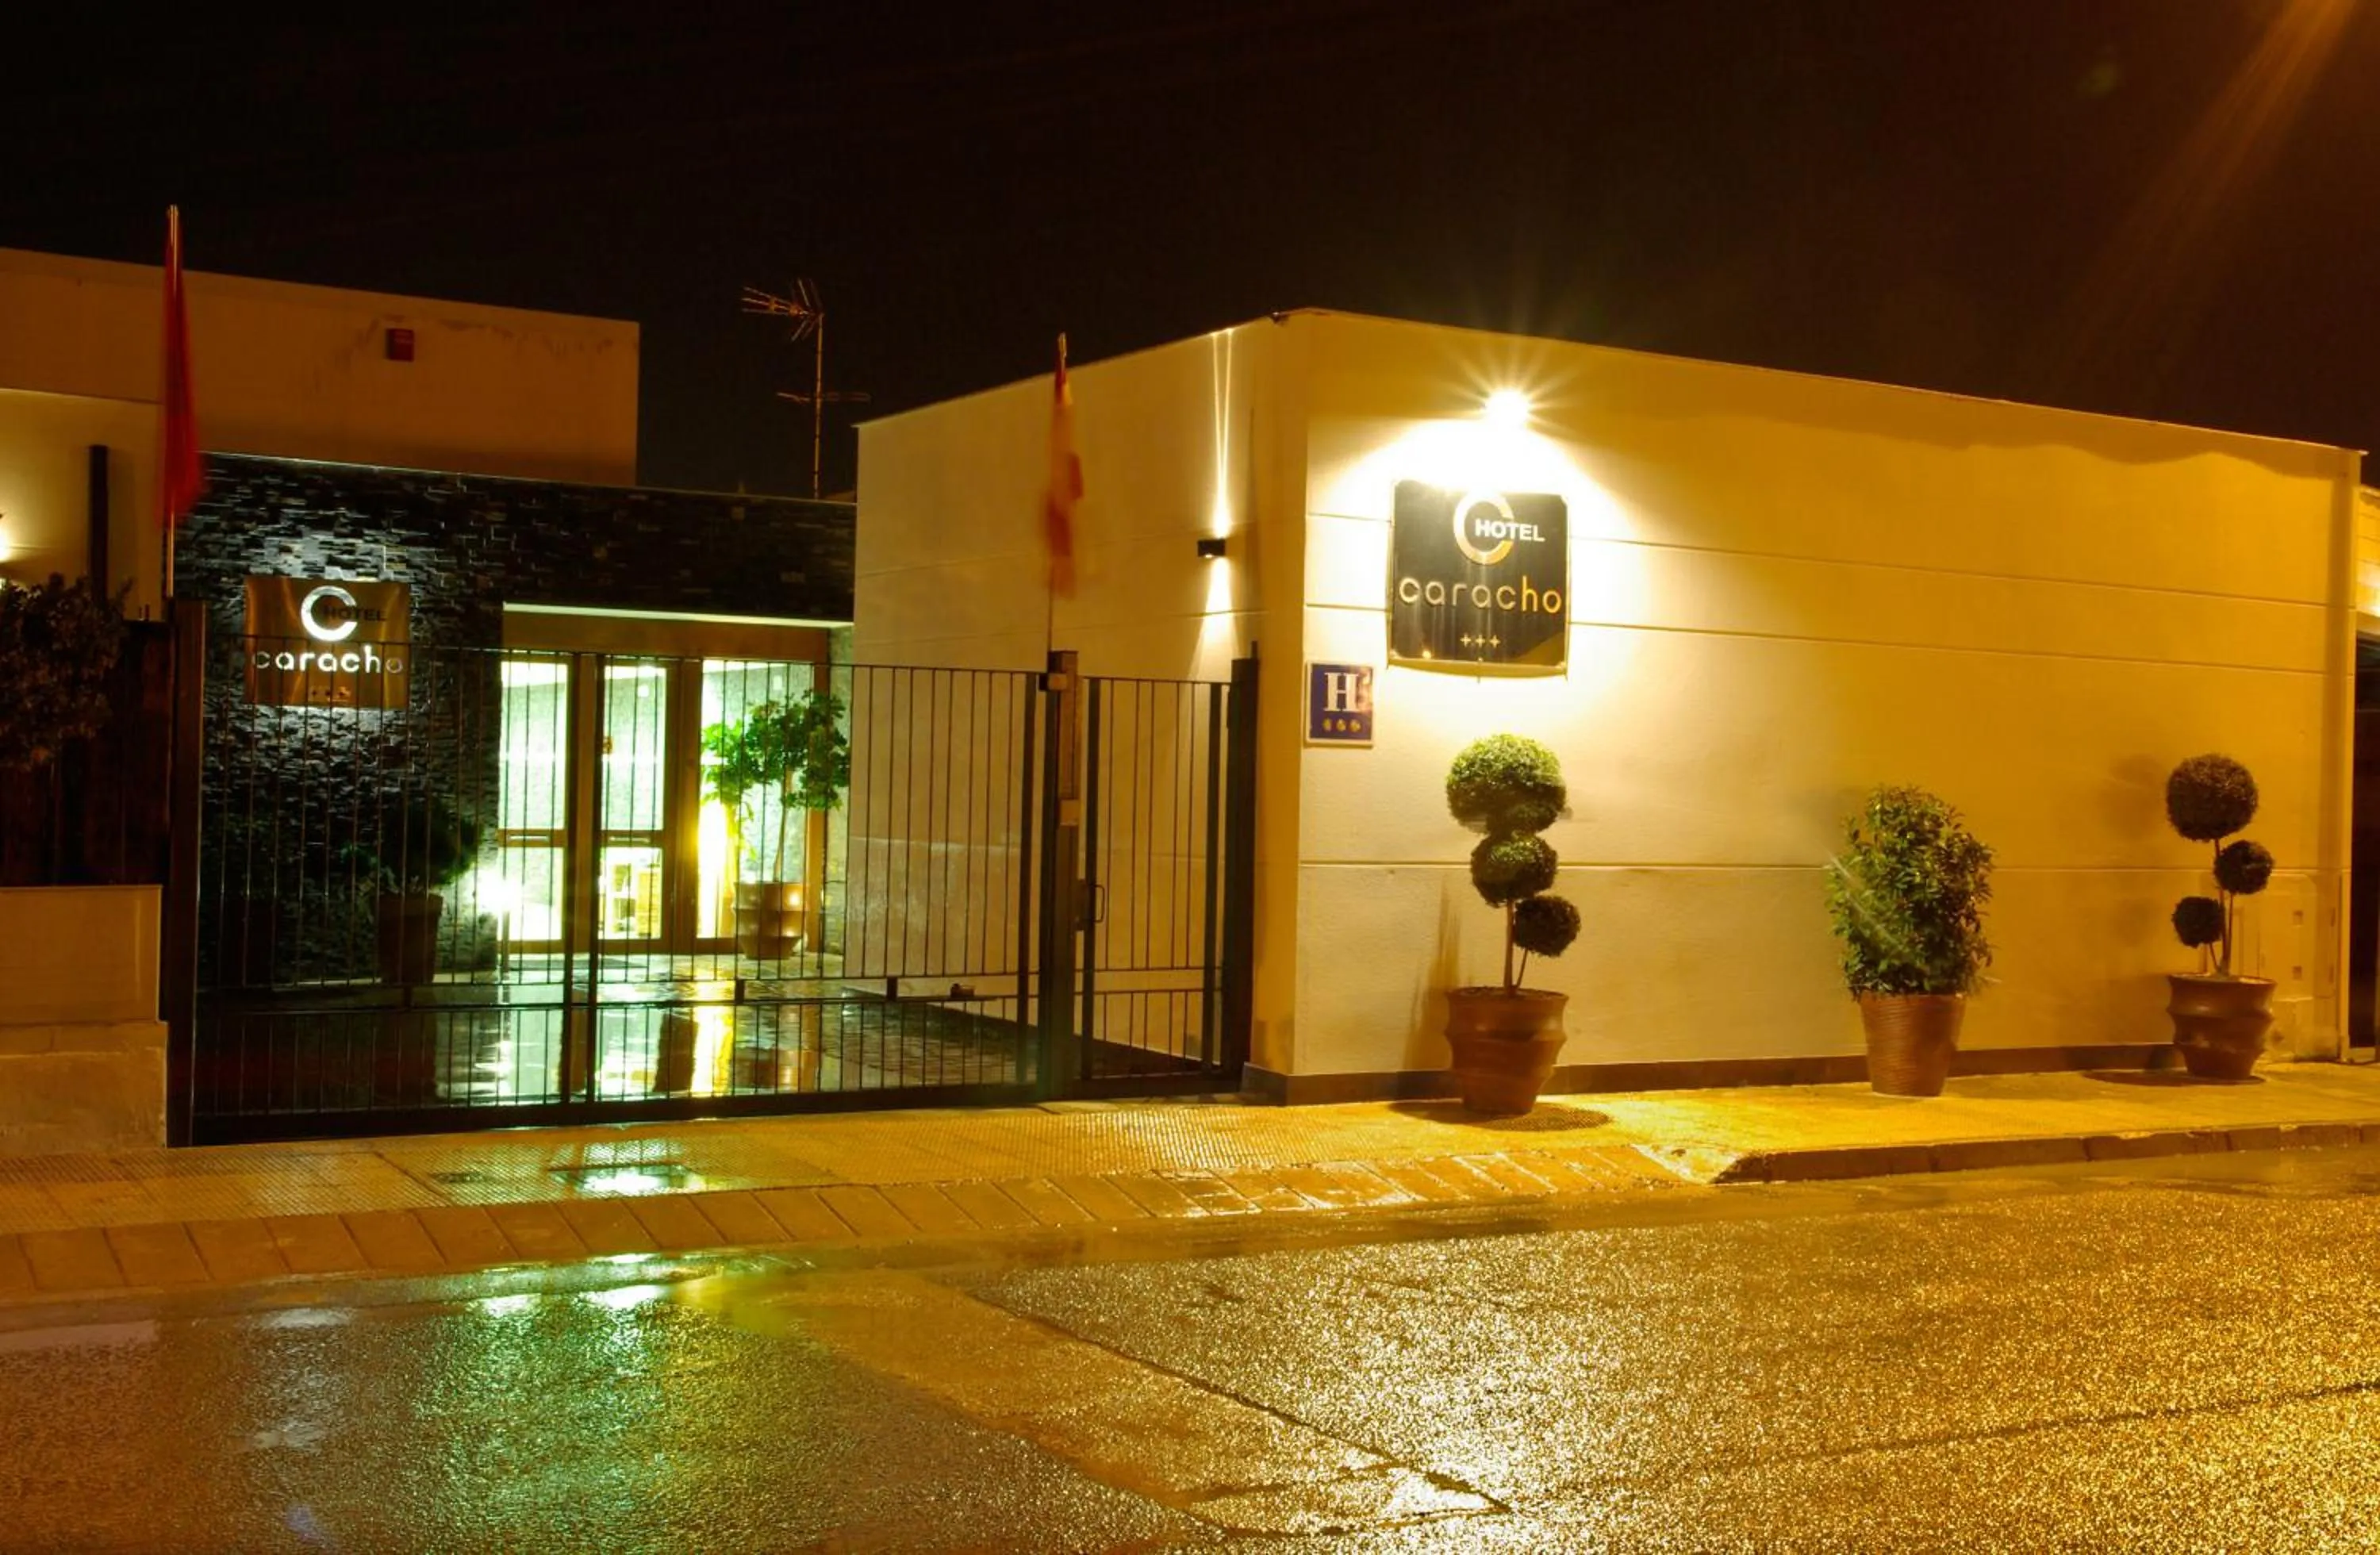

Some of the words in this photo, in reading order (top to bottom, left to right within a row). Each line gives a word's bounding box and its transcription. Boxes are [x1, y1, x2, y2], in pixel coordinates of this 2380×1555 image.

[1476, 519, 1545, 542] HOTEL
[1399, 576, 1561, 613] caracho
[323, 605, 387, 621] HOTEL
[253, 644, 403, 673] caracho
[1323, 672, 1360, 712] H
